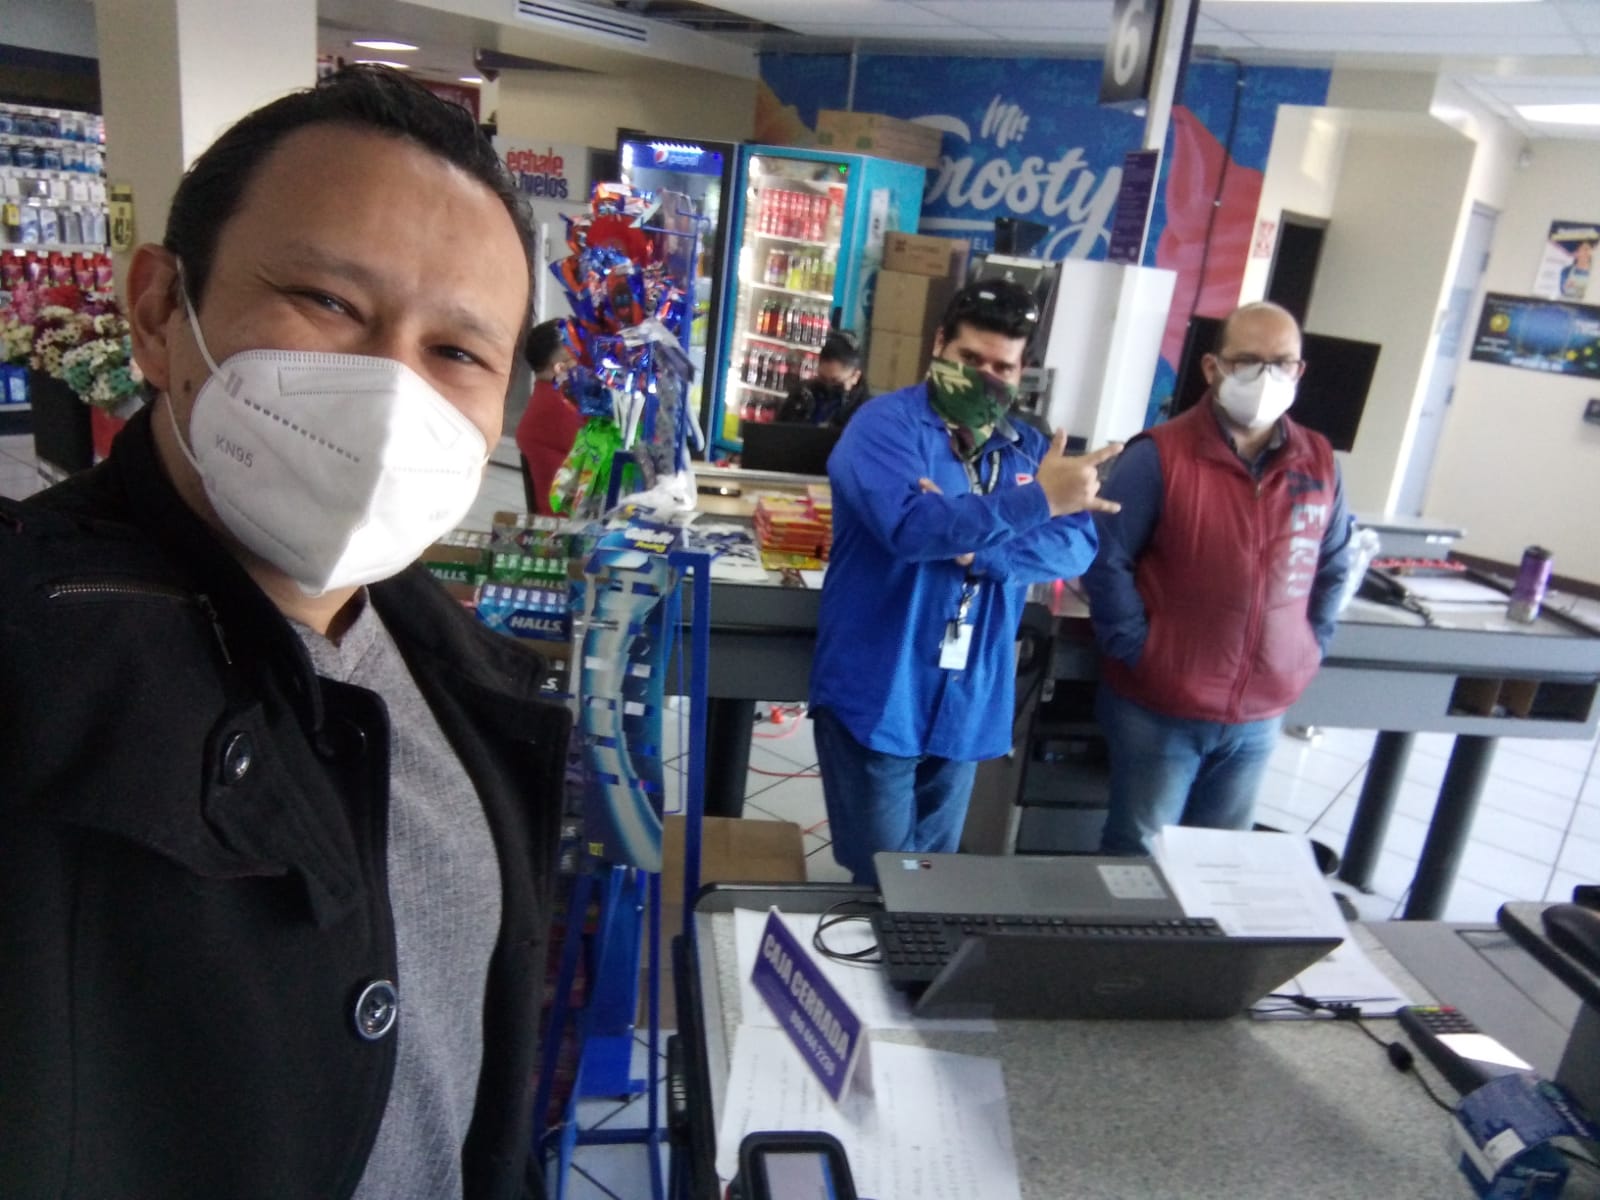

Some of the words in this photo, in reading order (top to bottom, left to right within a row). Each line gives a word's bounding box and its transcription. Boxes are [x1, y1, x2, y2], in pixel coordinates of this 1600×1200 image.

[1113, 0, 1144, 86] 6
[215, 433, 255, 469] KN95
[429, 567, 467, 582] ALLS
[509, 614, 563, 634] HALLS
[762, 933, 794, 985] CAJA
[790, 969, 850, 1061] CERRADA
